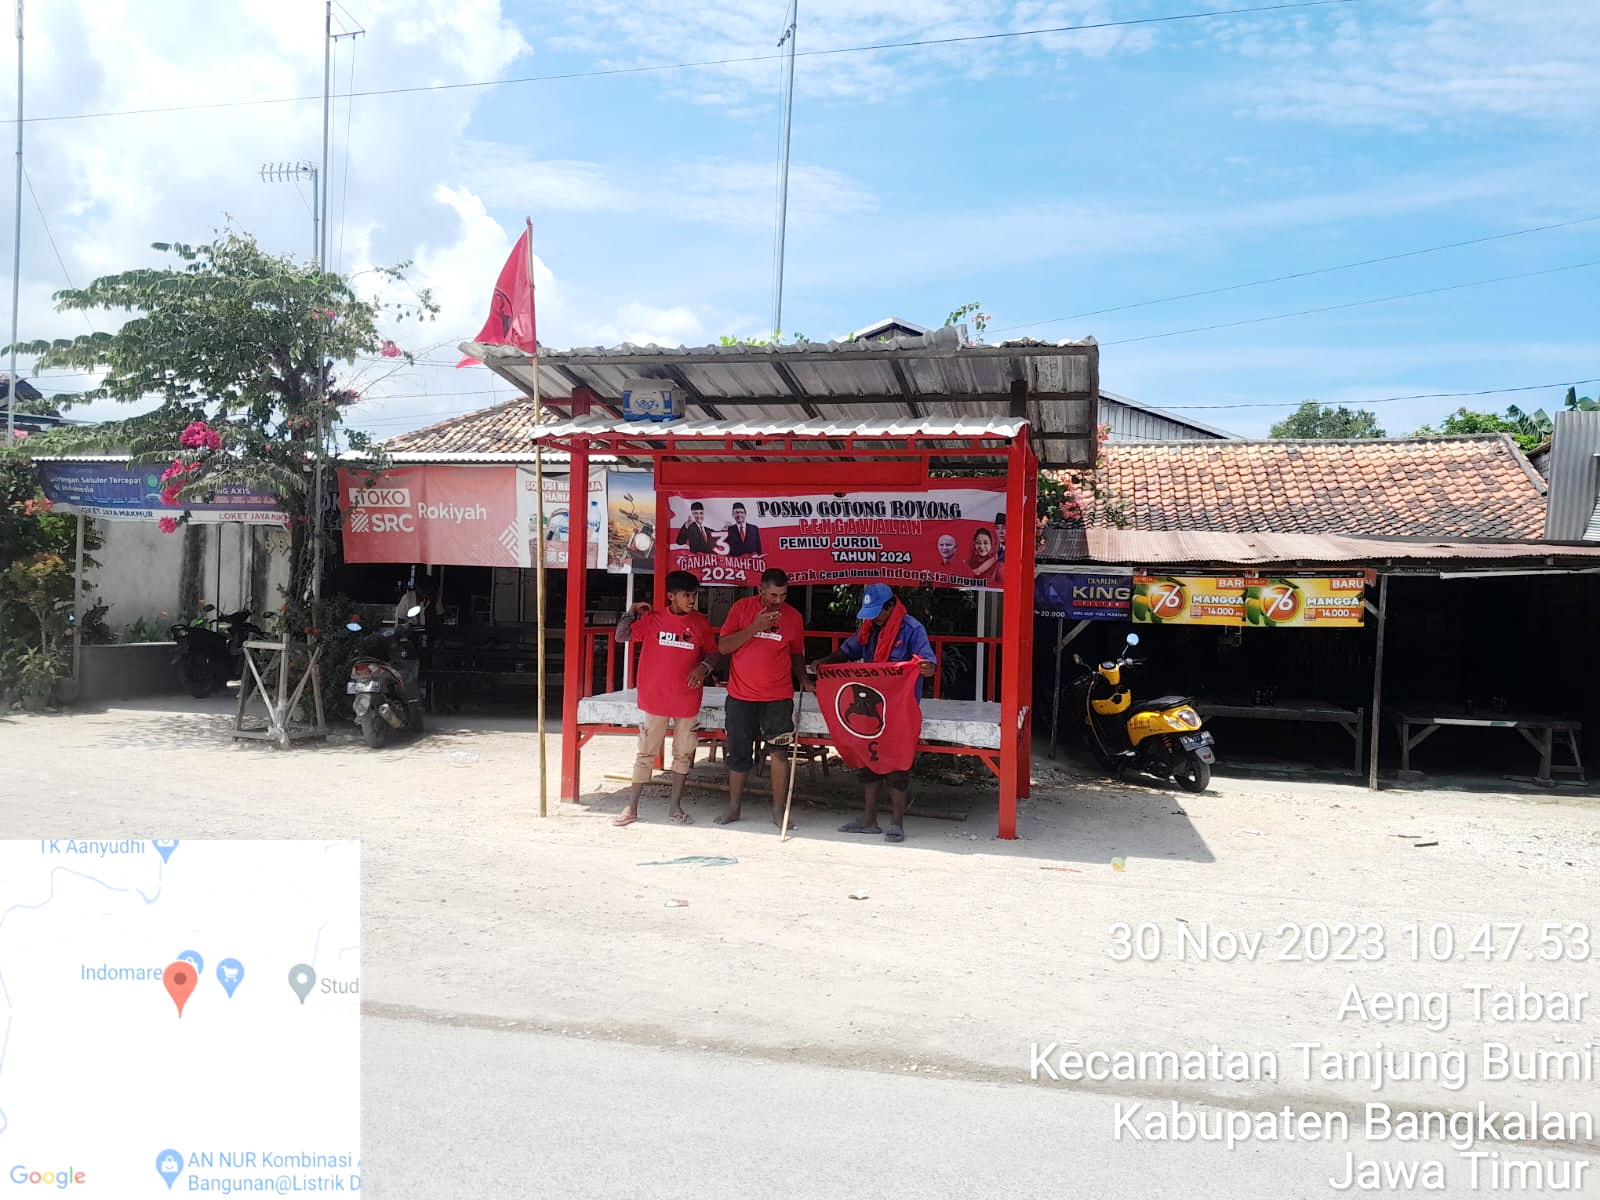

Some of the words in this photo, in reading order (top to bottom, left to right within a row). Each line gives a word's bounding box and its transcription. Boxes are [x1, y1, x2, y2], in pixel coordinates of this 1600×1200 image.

[230, 487, 250, 495] AXIS
[526, 481, 557, 492] SOUSI
[356, 489, 406, 505] TOKO
[119, 510, 154, 518] MAKMUR
[219, 512, 248, 520] LOKET
[250, 512, 271, 520] JAYA
[418, 502, 487, 524] Rokiyah
[757, 501, 812, 518] POSKO
[816, 500, 886, 518] GOTONG
[890, 500, 962, 519] ROYONG
[371, 514, 414, 532] SRC
[800, 518, 922, 535] PENGAWALAN
[711, 530, 730, 555] 3
[779, 537, 829, 549] PEMILU
[832, 536, 882, 549] JURDIL
[680, 554, 718, 572] GANJAR
[725, 556, 766, 573] MAHFUD
[831, 551, 876, 562] TAHUN
[880, 551, 911, 563] 2024
[702, 567, 747, 581] 2024
[786, 568, 817, 582] erak
[819, 570, 849, 580] Cepat
[850, 568, 880, 578] Untuk
[881, 567, 948, 583] Indonesia
[950, 576, 988, 587] Unggul
[1332, 579, 1364, 588] BARU
[1072, 586, 1131, 600] KING
[1151, 585, 1180, 614] 76
[1192, 595, 1244, 605] MANGGA
[1262, 587, 1294, 617] 76
[1306, 597, 1360, 606] MANGGA
[1207, 607, 1234, 616] 14.000
[1321, 609, 1350, 617] 14.000
[659, 631, 676, 640] PDI
